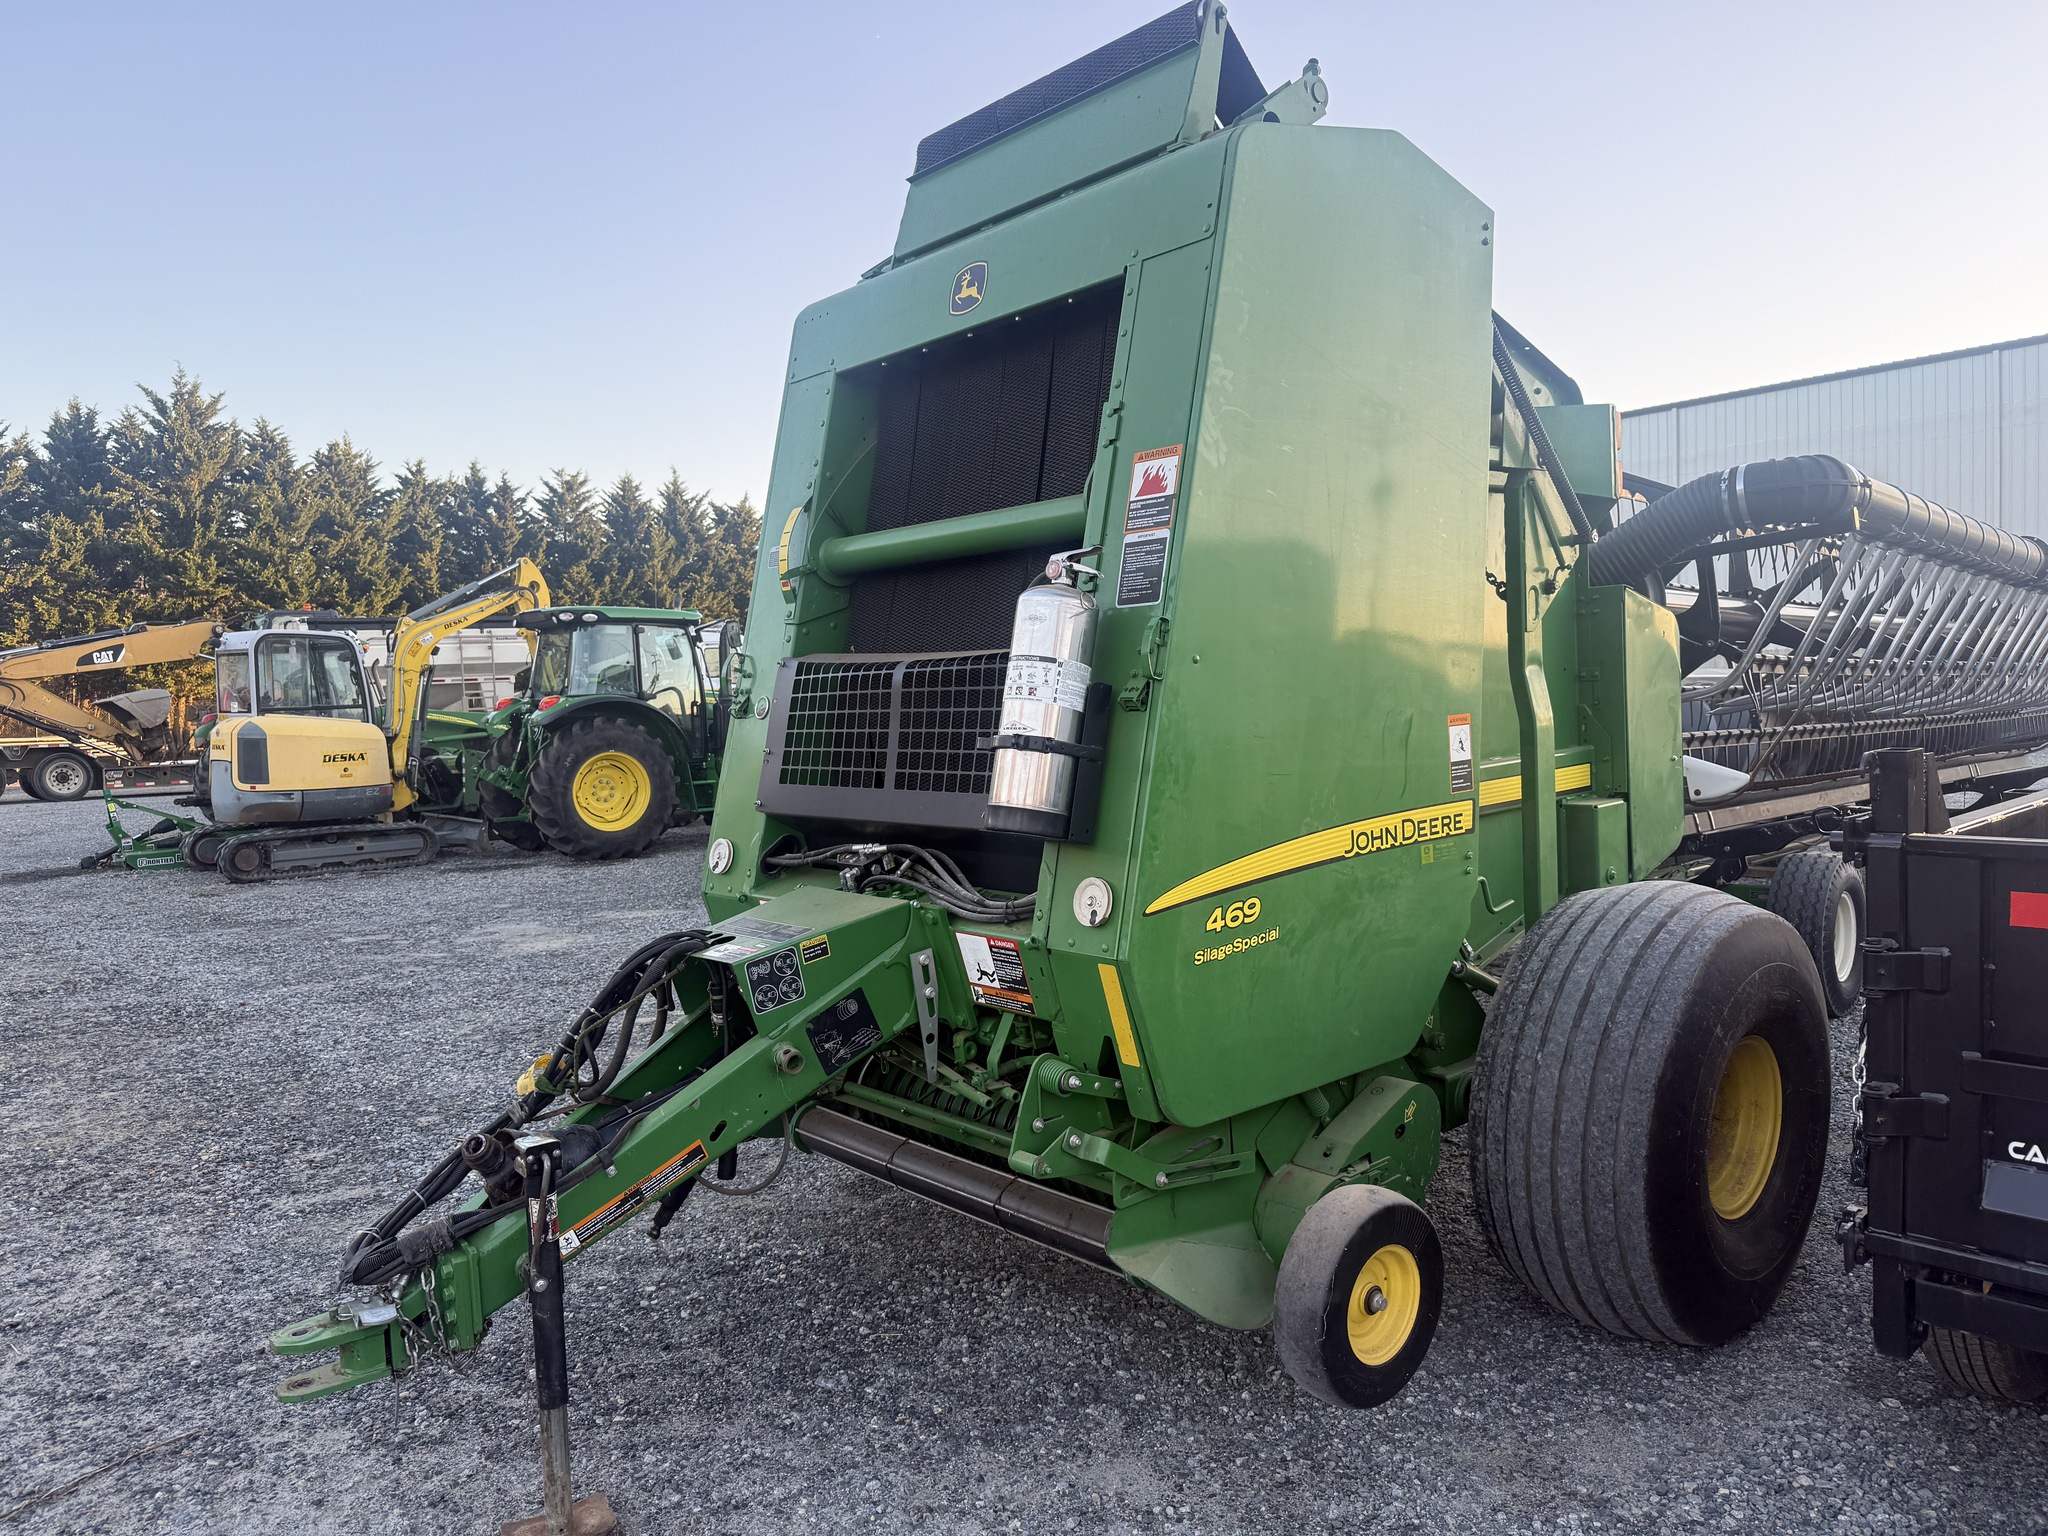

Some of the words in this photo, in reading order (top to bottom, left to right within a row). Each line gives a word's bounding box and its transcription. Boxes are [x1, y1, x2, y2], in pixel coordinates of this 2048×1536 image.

[1144, 446, 1178, 459] WARNING
[444, 616, 468, 630] DESKA
[92, 650, 114, 664] CAT
[322, 752, 367, 764] DESKA
[1344, 825, 1398, 855] JOHN
[1401, 813, 1464, 842] DEERE
[1205, 896, 1262, 933] 469
[994, 940, 1015, 948] DANGER
[1193, 925, 1280, 966] SilageSpecial
[2008, 1141, 2048, 1165] CA
[627, 1174, 653, 1194] WARNING
